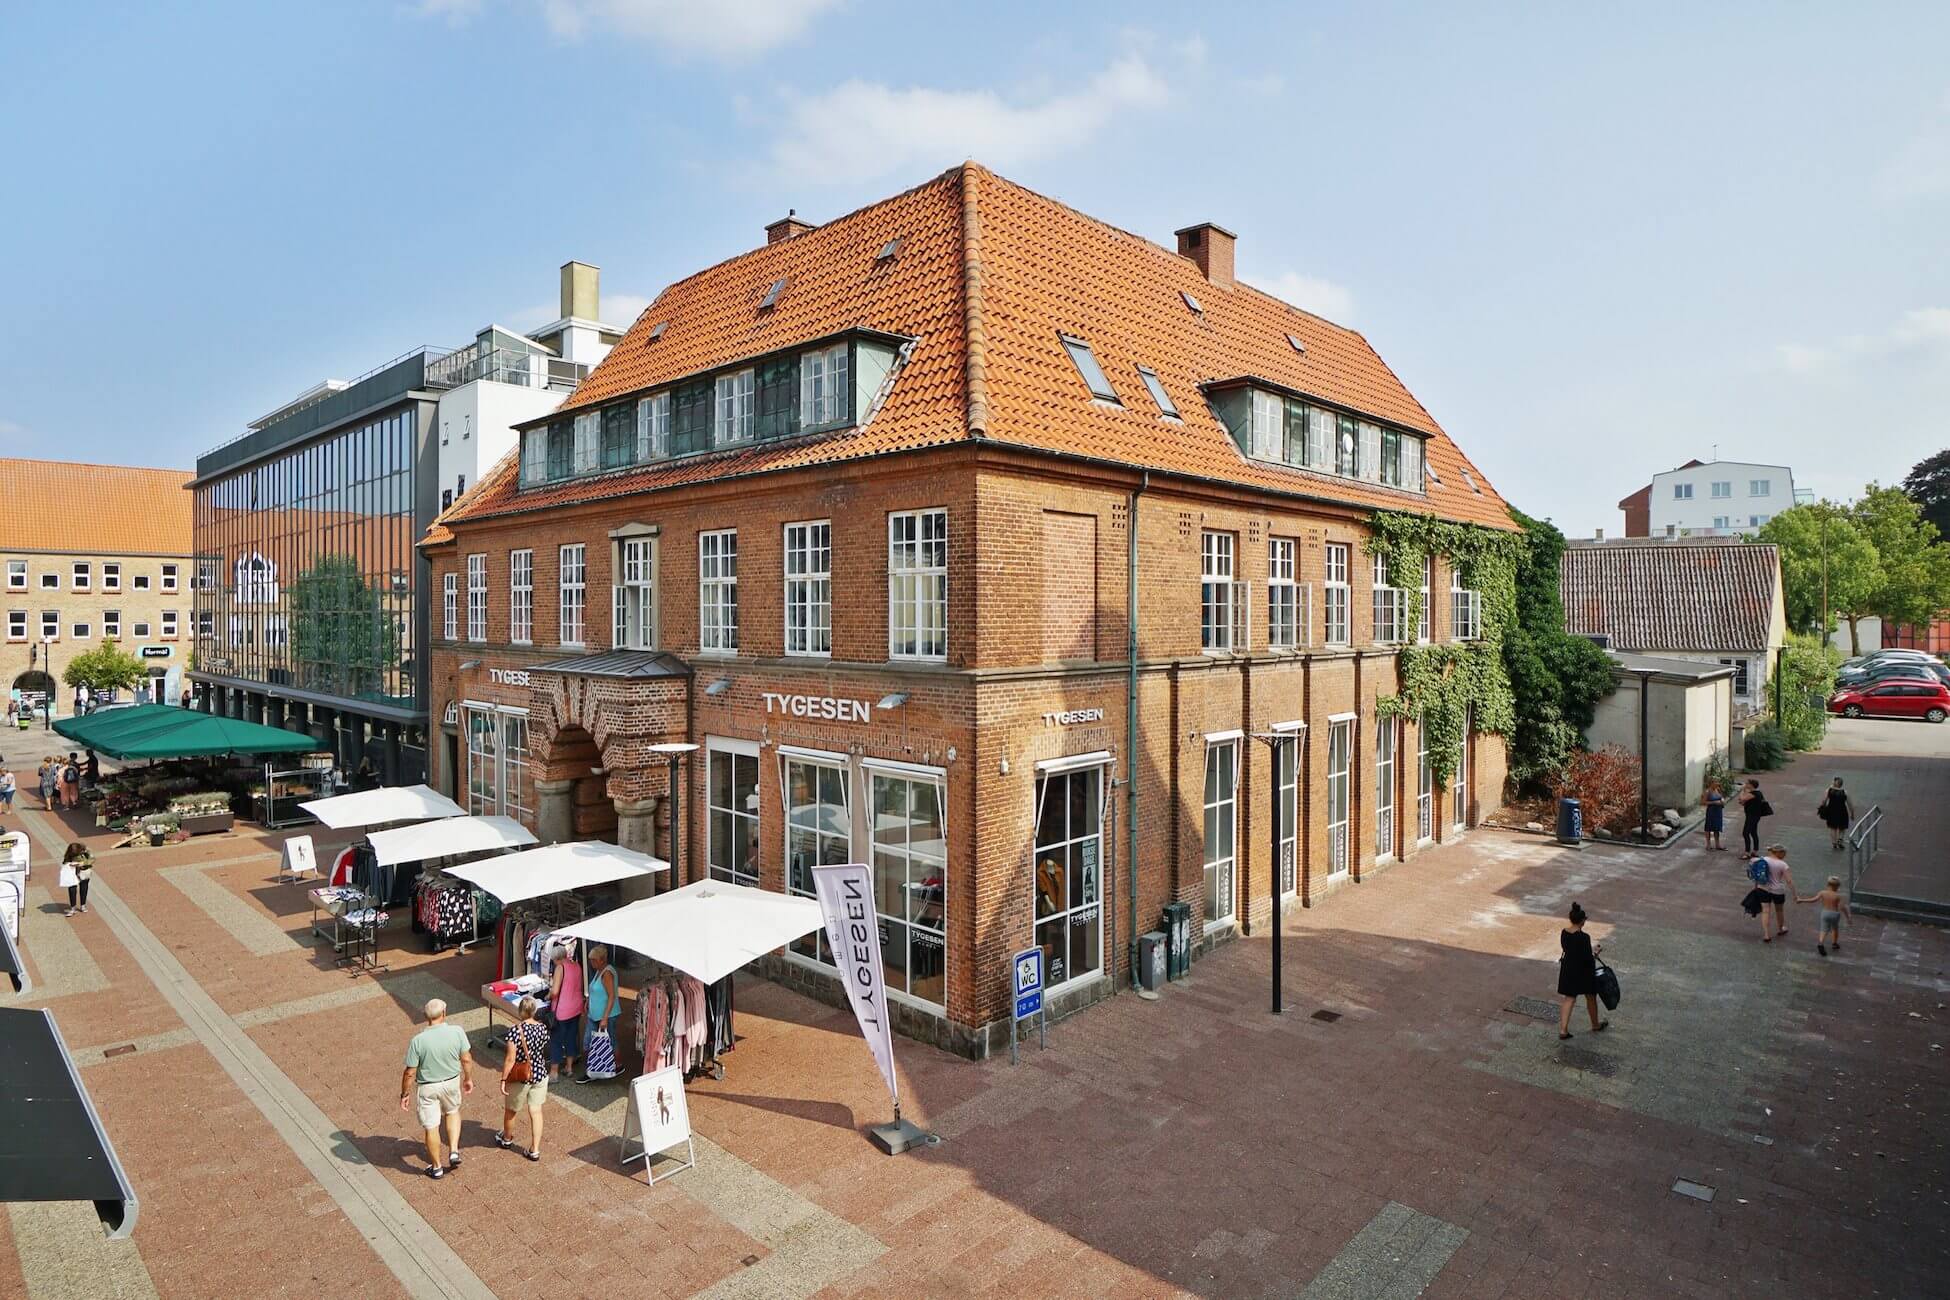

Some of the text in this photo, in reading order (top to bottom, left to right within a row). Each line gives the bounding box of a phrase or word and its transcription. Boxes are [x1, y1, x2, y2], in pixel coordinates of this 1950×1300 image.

[761, 692, 871, 723] TYGESEN
[1041, 708, 1104, 727] TYGESEN
[911, 930, 944, 946] TYGESEN
[1021, 972, 1036, 987] WC
